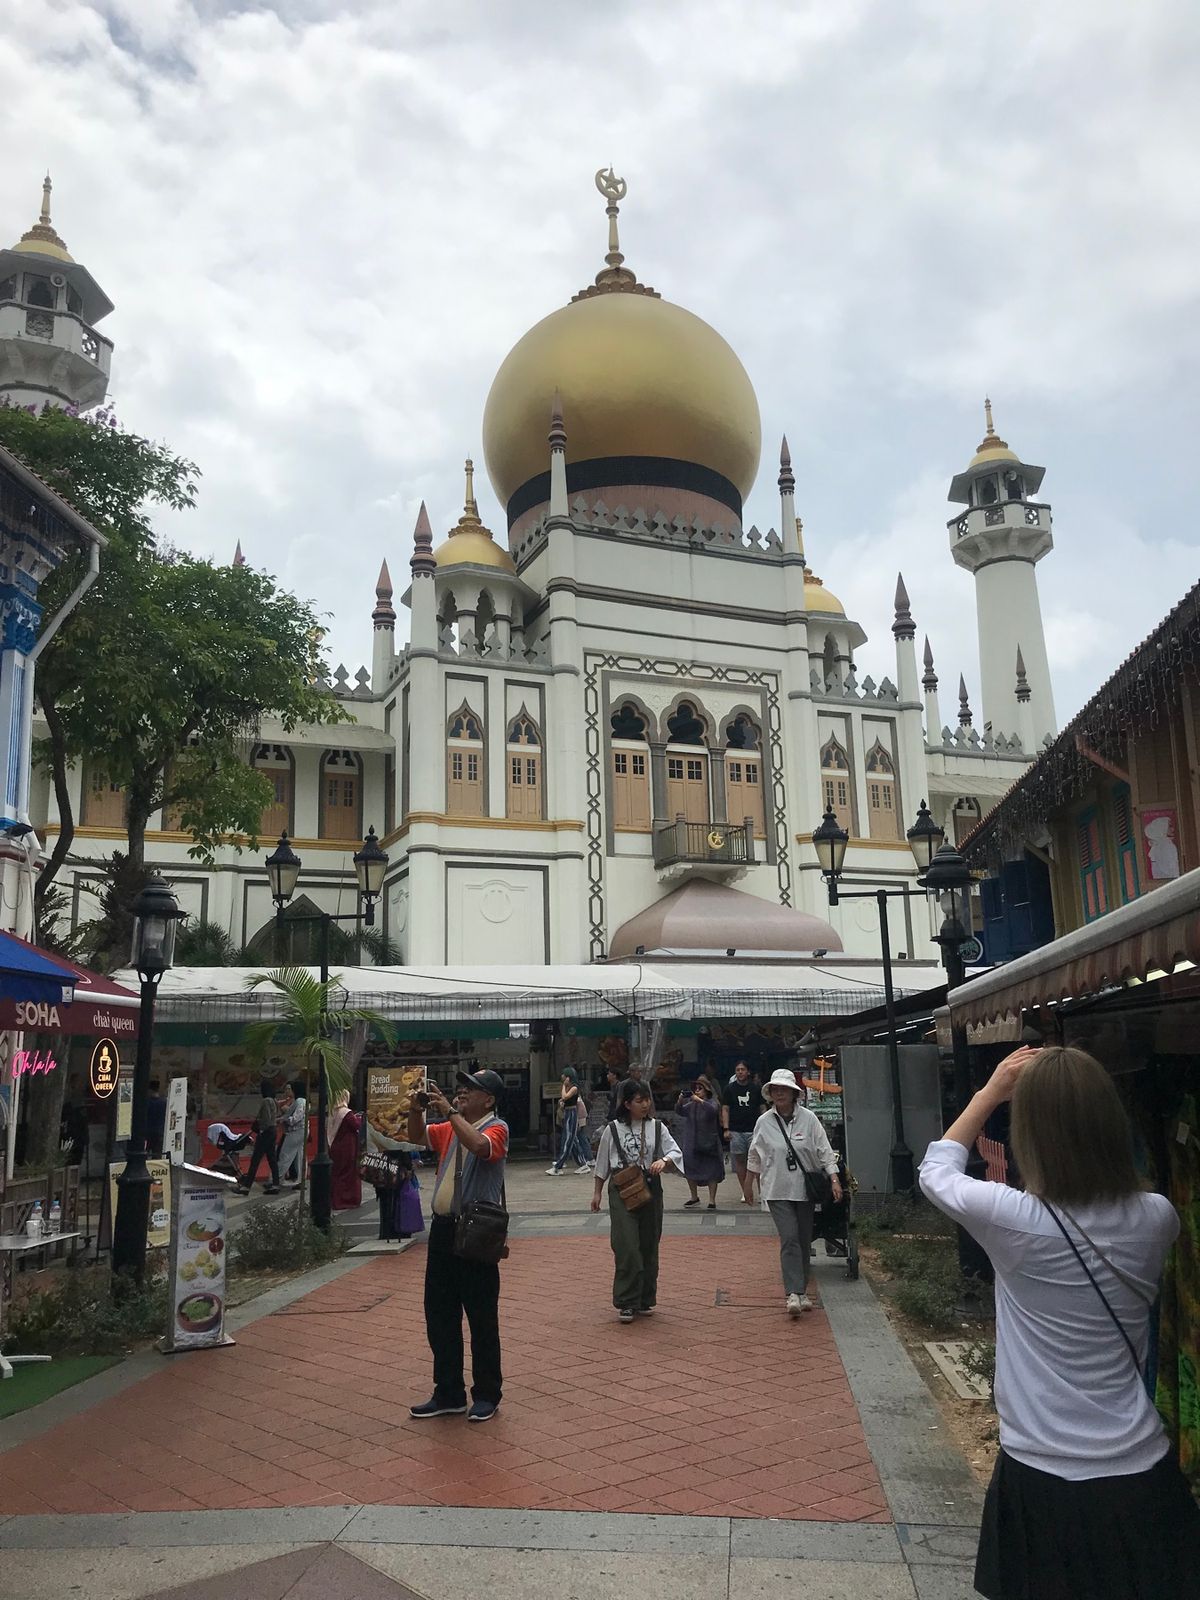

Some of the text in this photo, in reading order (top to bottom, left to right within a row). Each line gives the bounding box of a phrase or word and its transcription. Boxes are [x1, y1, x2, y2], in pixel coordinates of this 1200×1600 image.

[15, 1001, 61, 1027] SOHA
[93, 1010, 135, 1033] chai queen
[98, 1074, 111, 1082] CHAI
[371, 1074, 390, 1084] Bread
[370, 1083, 399, 1095] Pudding
[151, 1169, 168, 1177] CHAI
